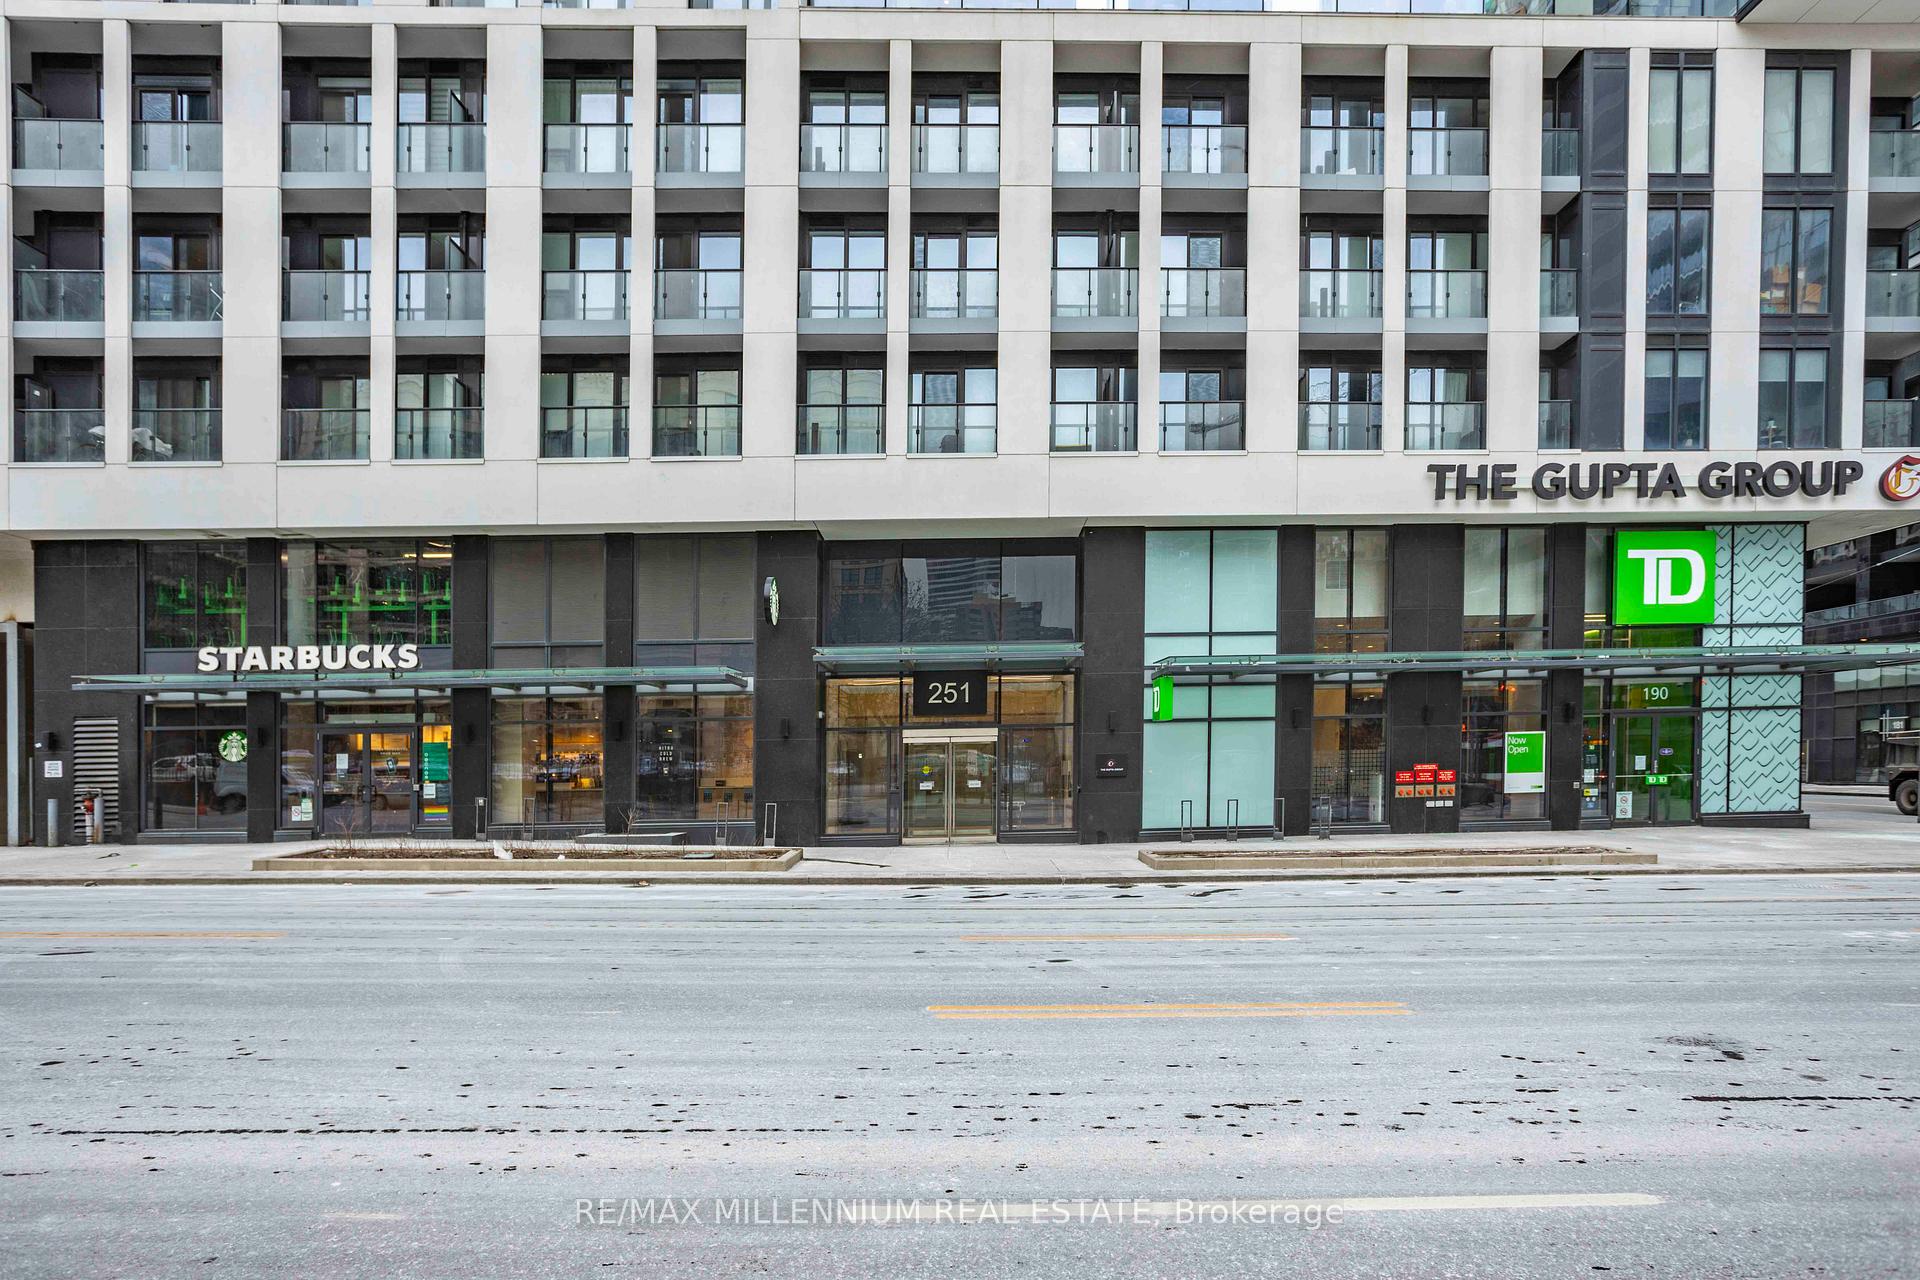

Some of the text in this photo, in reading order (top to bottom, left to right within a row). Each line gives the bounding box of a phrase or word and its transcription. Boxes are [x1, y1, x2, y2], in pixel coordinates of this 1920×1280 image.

[1427, 460, 1864, 501] THE GUPTA GROUP
[1627, 548, 1706, 605] TD
[197, 643, 419, 672] STARBUCKS
[928, 682, 970, 704] 251
[1643, 687, 1669, 700] 190
[1507, 745, 1529, 755] Open
[1508, 736, 1527, 745] Now
